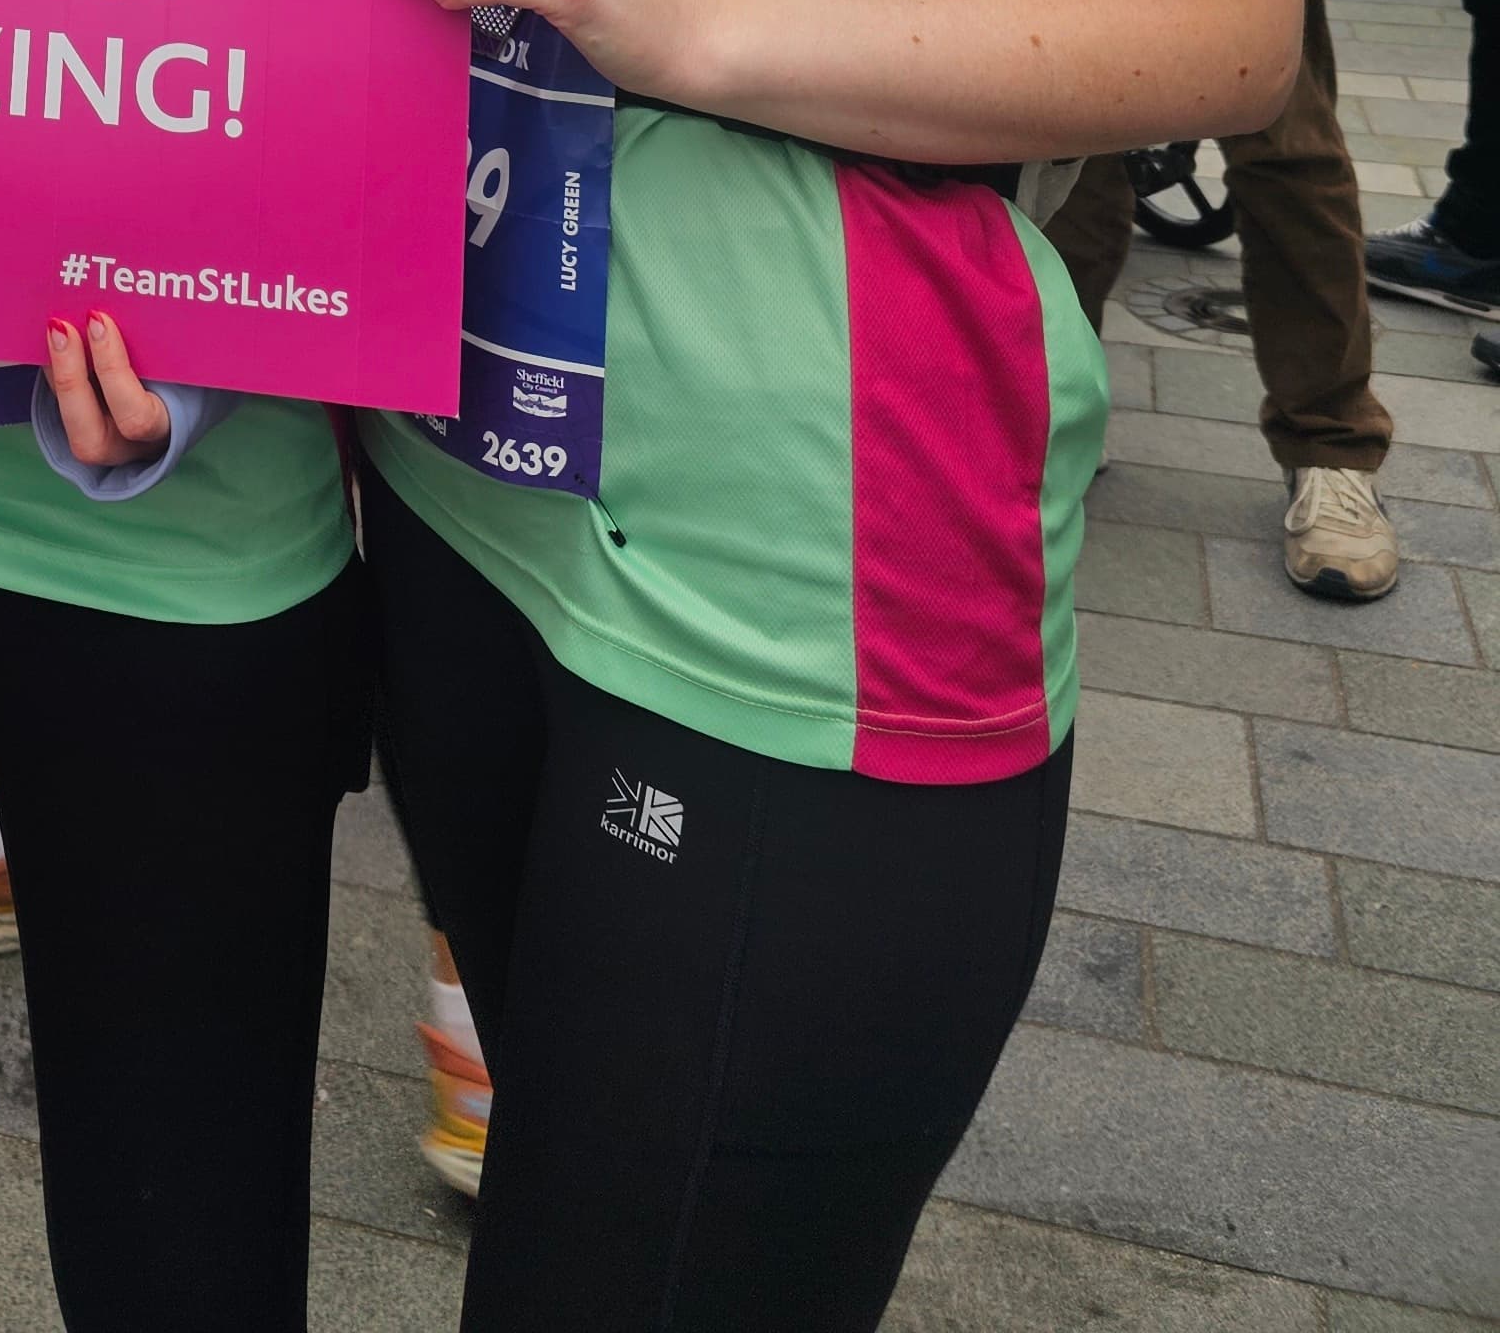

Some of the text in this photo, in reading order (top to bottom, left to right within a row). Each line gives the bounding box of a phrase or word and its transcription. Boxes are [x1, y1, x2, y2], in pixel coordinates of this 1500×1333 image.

[560, 171, 581, 291] LUCY GREEN
[59, 252, 351, 318] #TeamStLukes
[516, 368, 565, 389] Sheffield
[482, 430, 568, 477] 2639
[600, 813, 678, 865] karrimor
